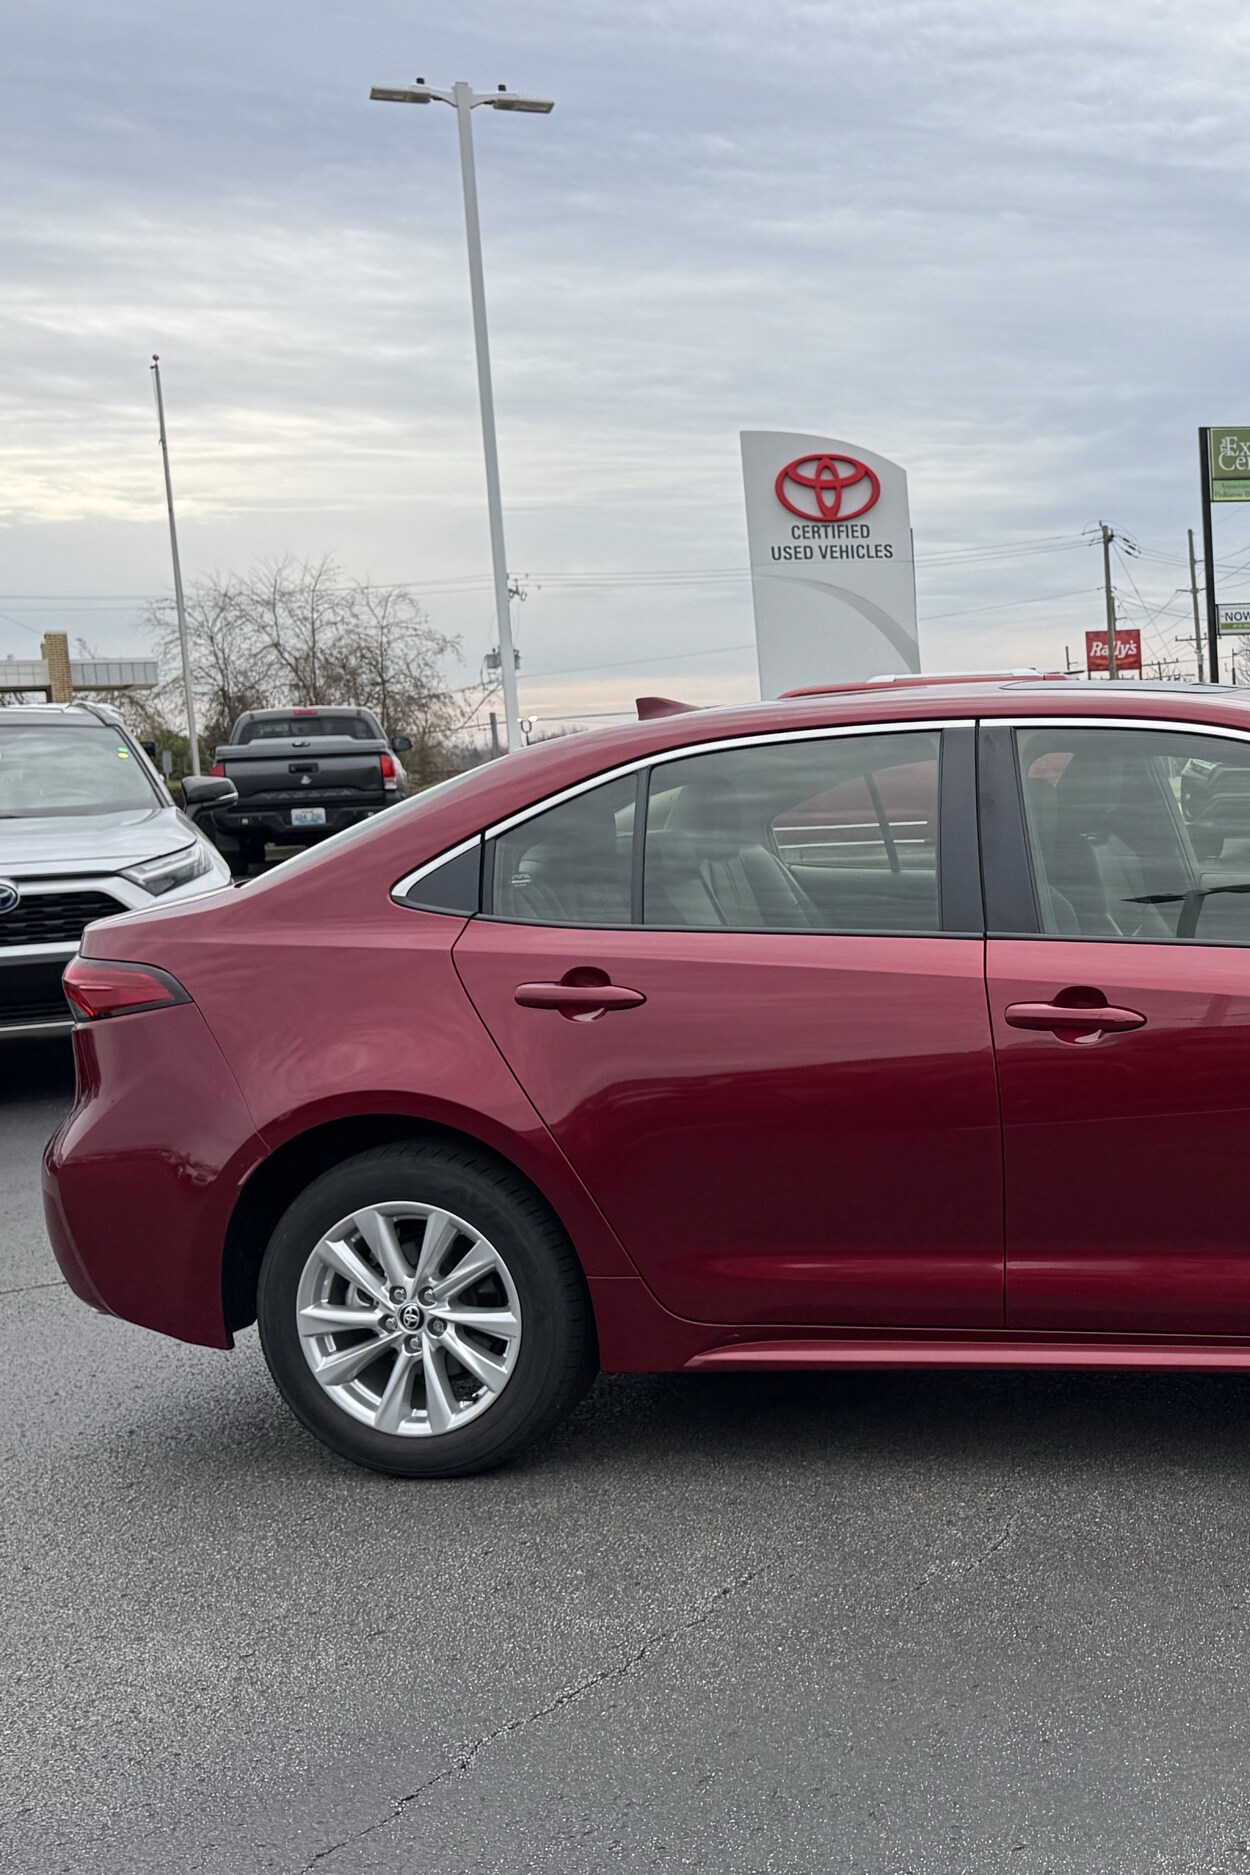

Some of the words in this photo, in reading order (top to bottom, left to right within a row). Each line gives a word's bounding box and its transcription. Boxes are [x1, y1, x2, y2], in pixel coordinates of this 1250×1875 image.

[791, 524, 870, 540] CERTIFIED
[771, 545, 814, 561] USED
[818, 544, 893, 560] VEHICLES
